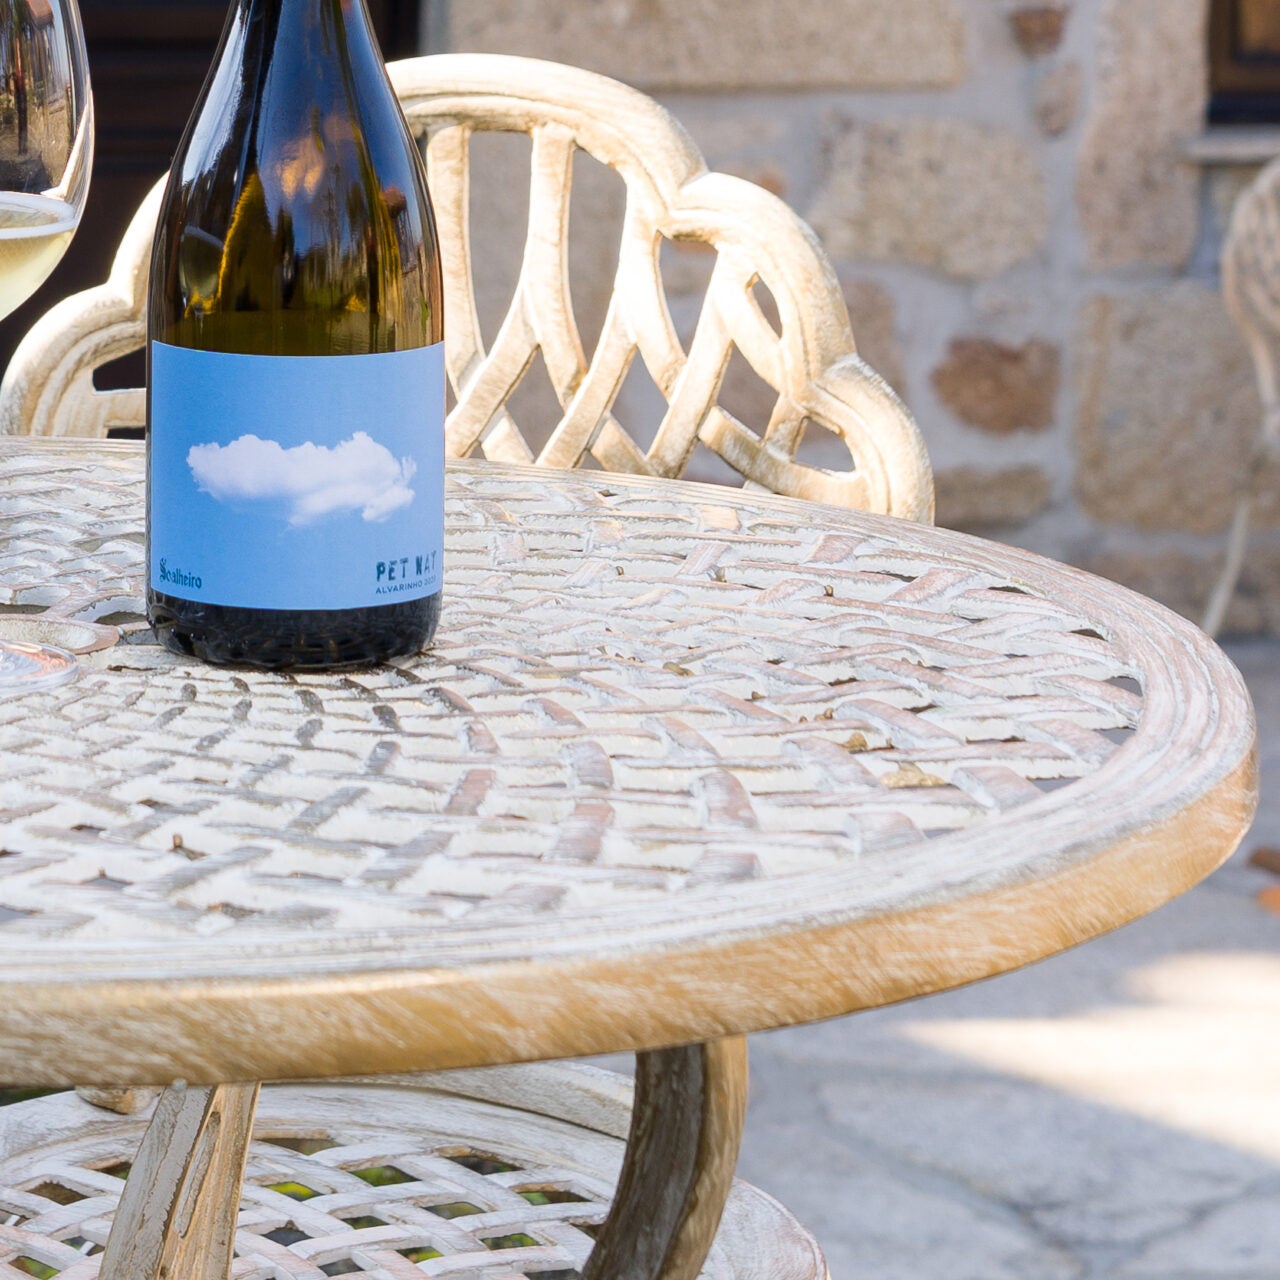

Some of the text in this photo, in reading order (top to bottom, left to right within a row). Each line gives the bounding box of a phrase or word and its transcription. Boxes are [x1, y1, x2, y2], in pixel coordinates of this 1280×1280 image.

[159, 557, 202, 589] Soalheiro
[376, 557, 408, 582] PET
[376, 580, 423, 595] ALVARINHO
